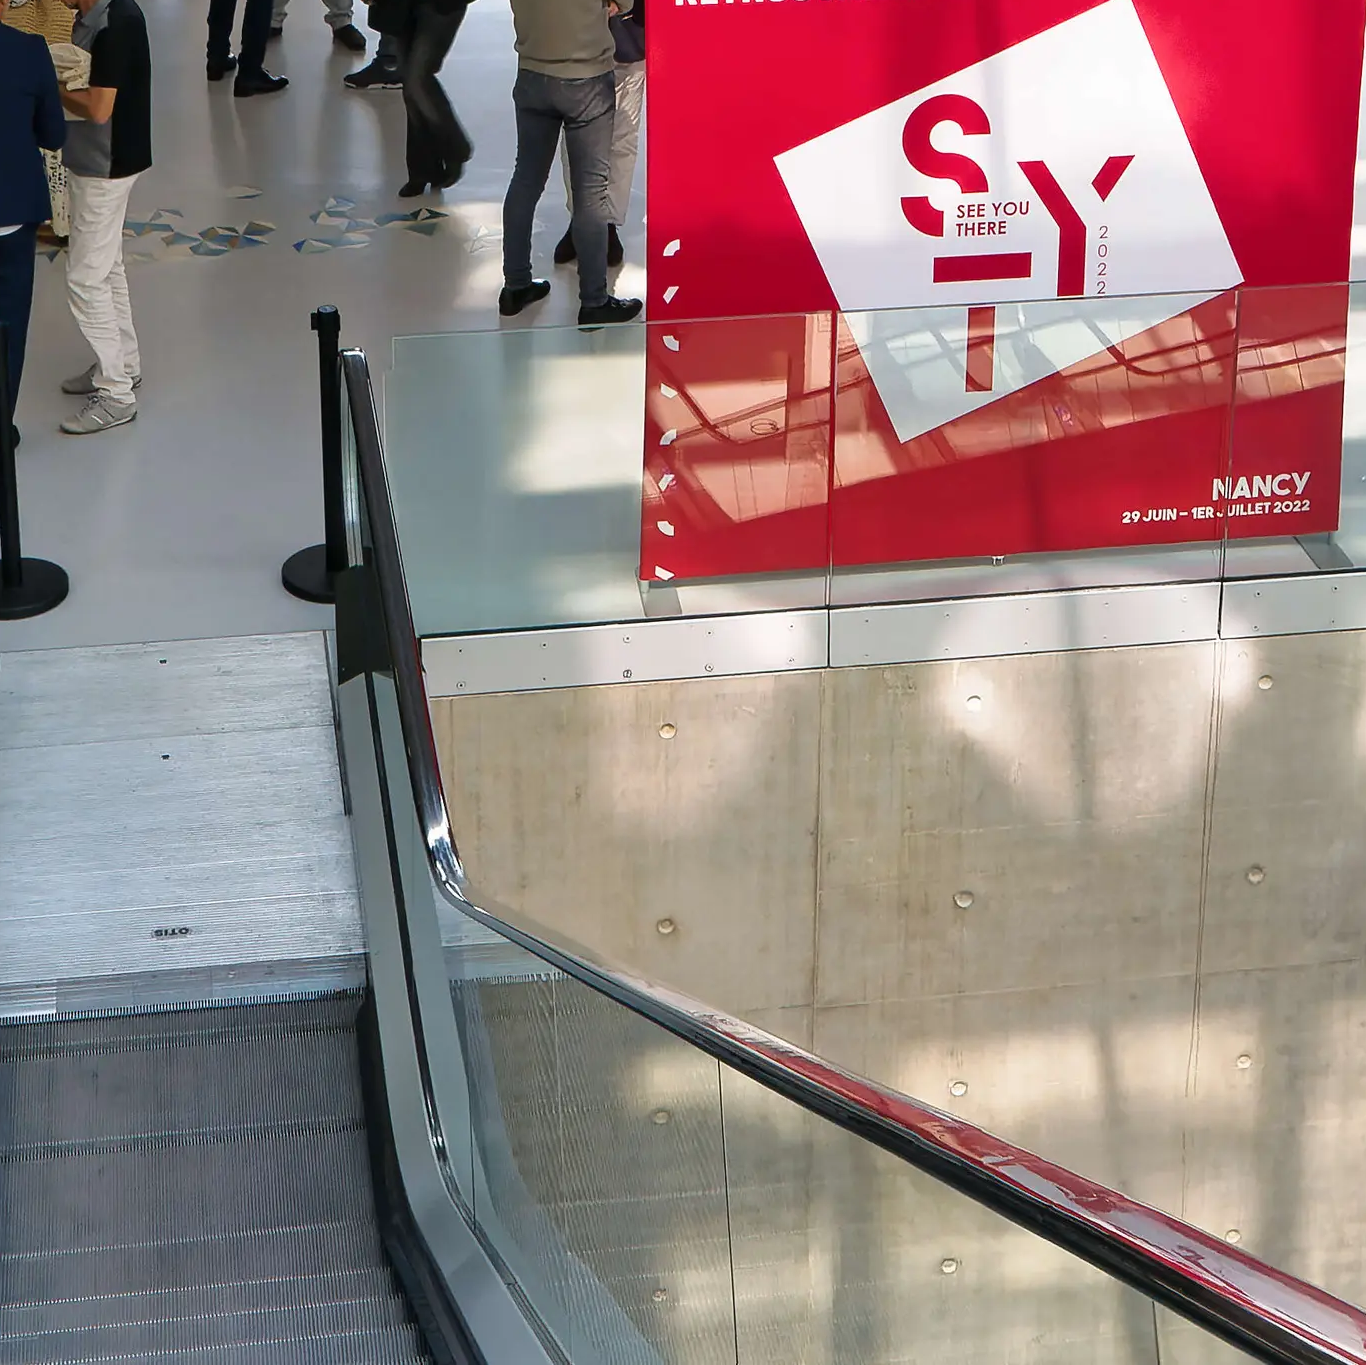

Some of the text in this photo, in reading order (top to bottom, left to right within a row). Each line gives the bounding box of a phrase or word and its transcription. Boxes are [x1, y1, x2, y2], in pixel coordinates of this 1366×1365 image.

[957, 201, 1029, 218] SEE YOU
[956, 221, 1007, 237] THERE
[1212, 471, 1311, 501] NANCY
[1122, 508, 1141, 523] 29
[1142, 508, 1177, 522] JUIN
[1191, 506, 1214, 520] 1ER
[1273, 499, 1310, 514] 2022
[154, 927, 189, 937] OTIS
